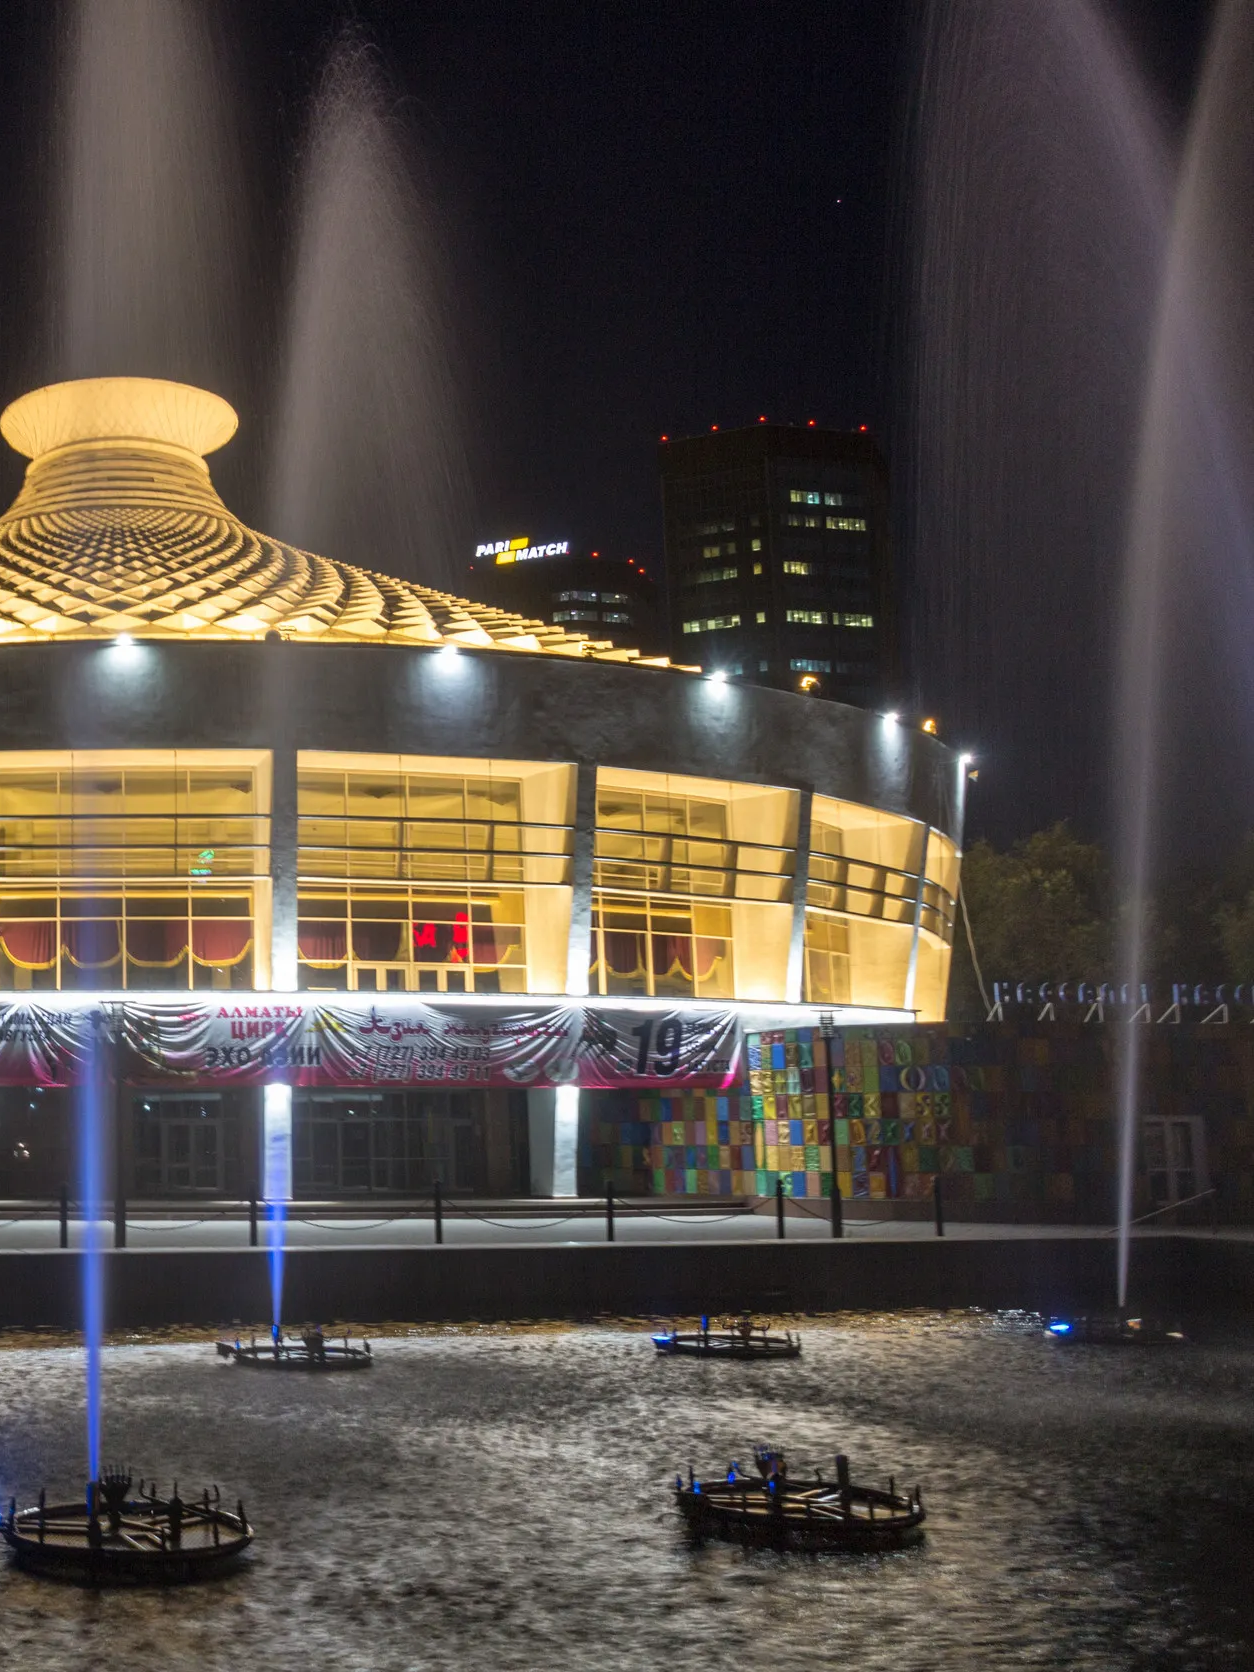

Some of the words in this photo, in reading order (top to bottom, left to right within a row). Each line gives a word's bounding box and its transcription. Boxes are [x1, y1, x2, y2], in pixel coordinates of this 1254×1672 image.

[475, 540, 510, 557] PARI
[515, 541, 568, 561] MATCH
[216, 1006, 303, 1018] АЛМАТЫ
[231, 1021, 286, 1040] ЦИРК
[205, 1046, 251, 1066] ЭХО
[632, 1018, 682, 1075] 19
[473, 1064, 490, 1080] 11
